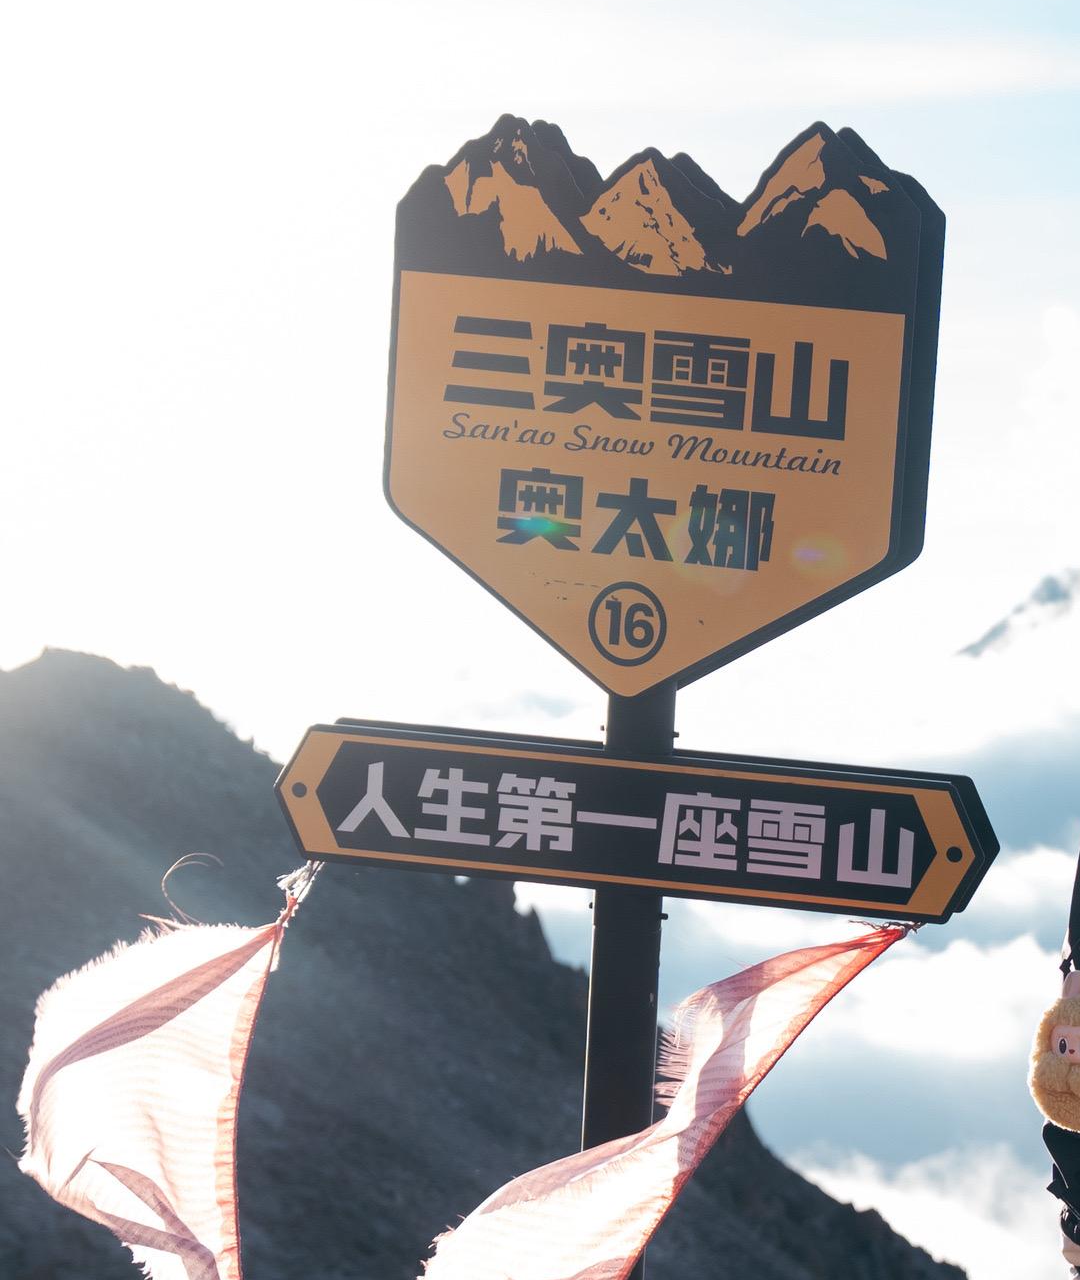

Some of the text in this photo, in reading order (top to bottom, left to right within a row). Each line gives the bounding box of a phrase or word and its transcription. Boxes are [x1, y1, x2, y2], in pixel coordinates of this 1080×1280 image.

[443, 315, 850, 441] 三奥雪山
[443, 411, 842, 476] San'ao Snow Mountain
[495, 467, 776, 572] 奥太娜
[605, 599, 655, 649] 16
[336, 760, 915, 889] 人生第一座雪山
